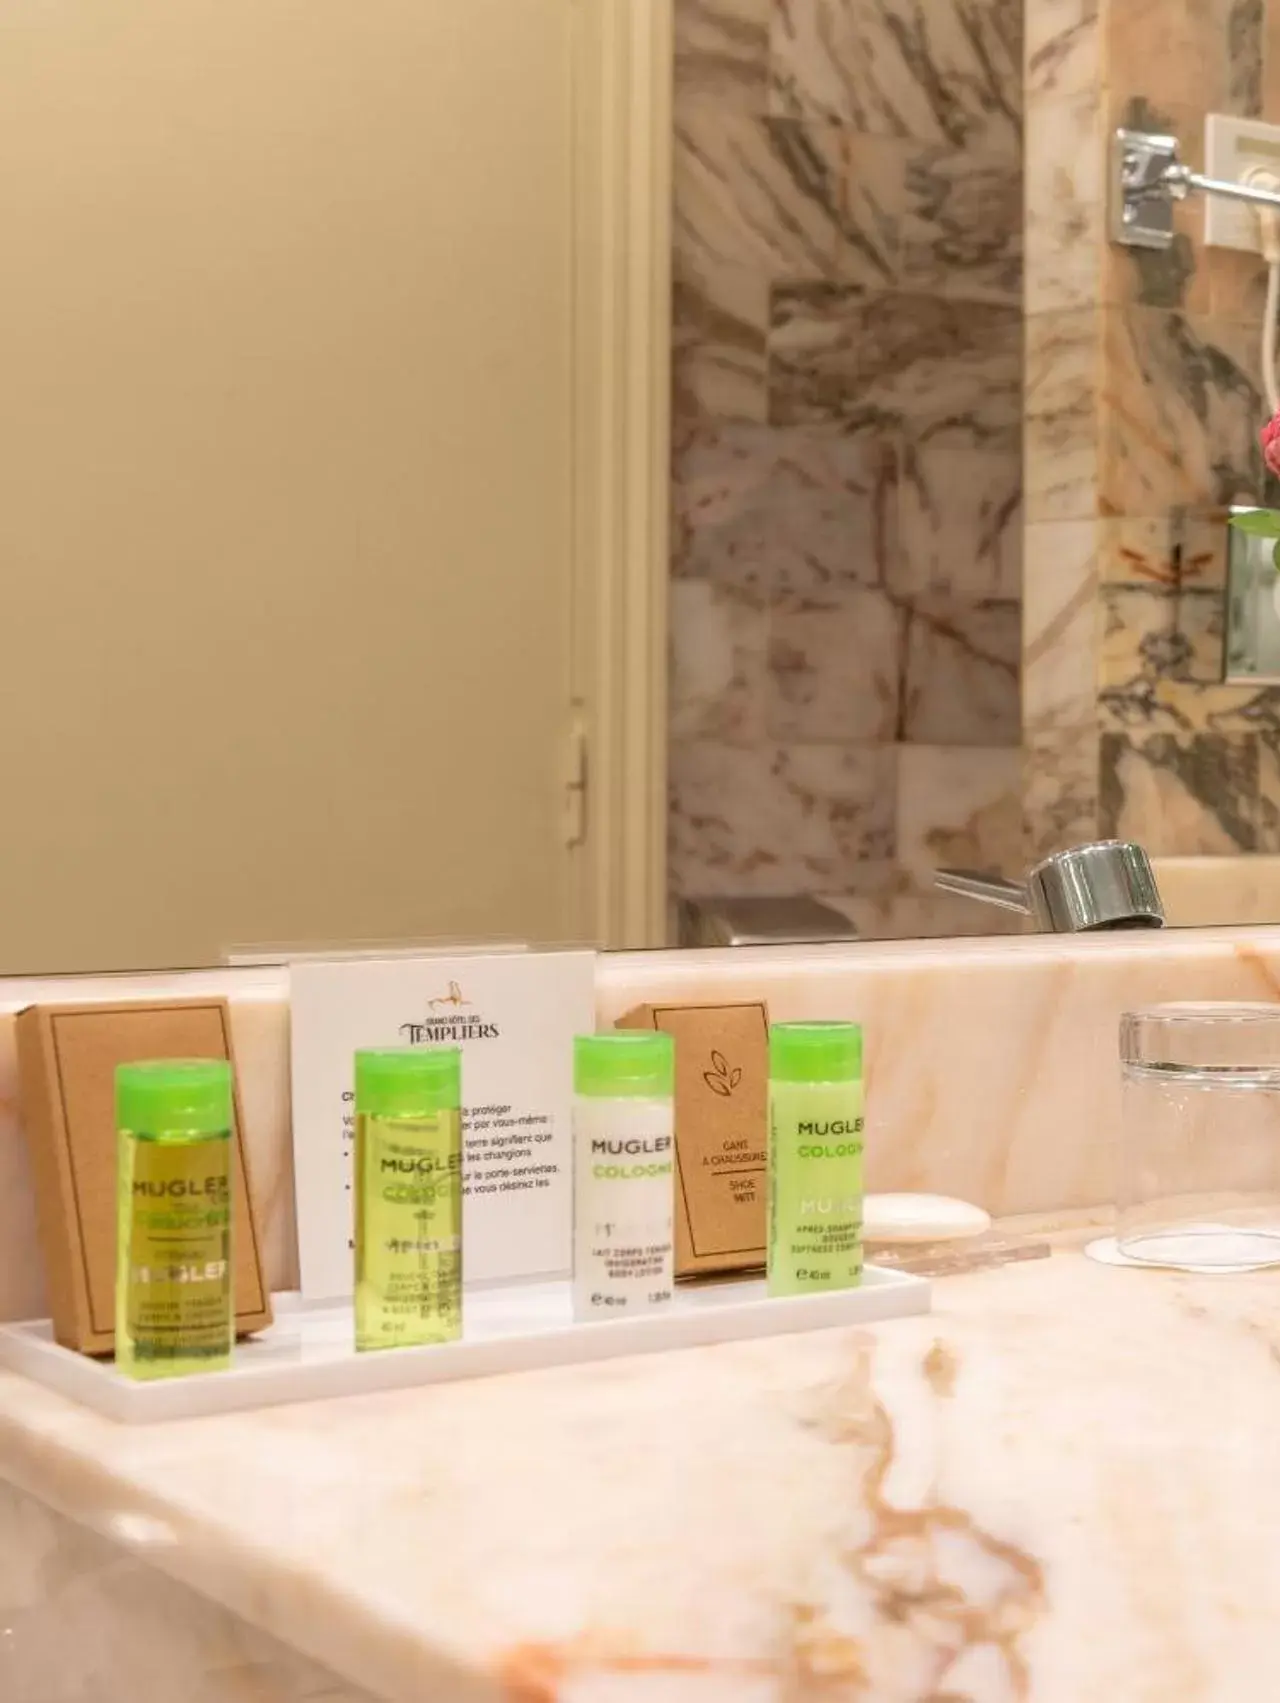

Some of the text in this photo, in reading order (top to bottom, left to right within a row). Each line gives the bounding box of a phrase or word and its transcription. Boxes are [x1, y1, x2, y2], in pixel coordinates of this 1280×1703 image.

[399, 1022, 500, 1045] TEMPLIERS
[474, 1121, 491, 1132] par
[797, 1117, 863, 1136] MUGLE
[465, 1139, 489, 1149] terre
[534, 1134, 553, 1145] que
[380, 1152, 461, 1174] MUGLE
[474, 1184, 498, 1194] vous
[535, 1177, 550, 1188] les
[729, 1180, 756, 1191] SHOE
